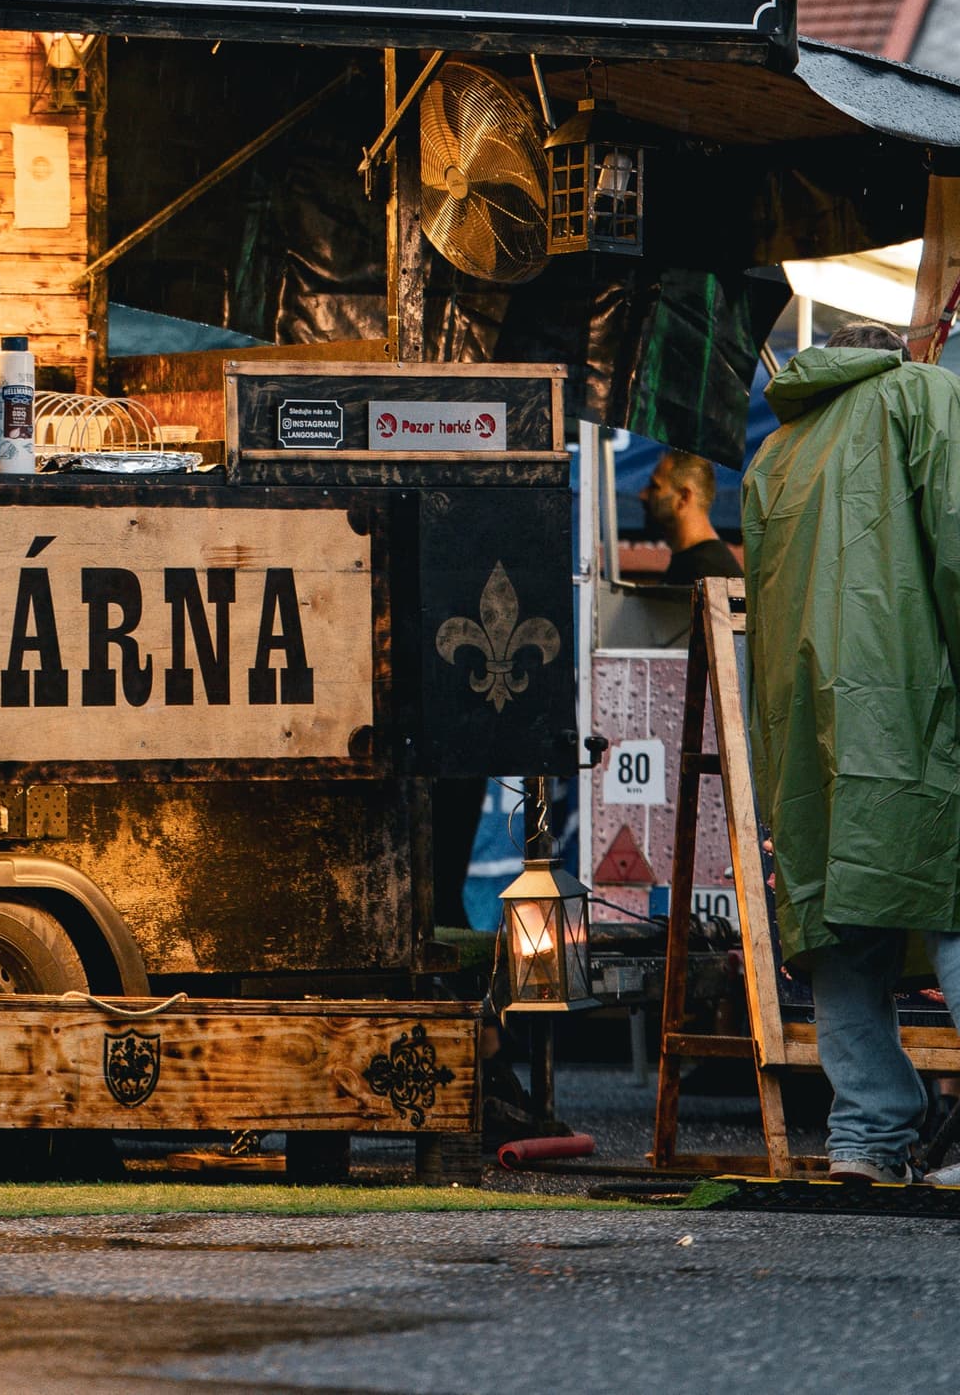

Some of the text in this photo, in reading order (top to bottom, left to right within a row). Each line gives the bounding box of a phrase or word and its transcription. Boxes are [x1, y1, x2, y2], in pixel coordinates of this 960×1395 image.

[292, 420, 339, 429] INSTAGRAMU
[401, 419, 472, 434] Pozor horké
[617, 752, 650, 785] 80
[626, 786, 643, 794] km
